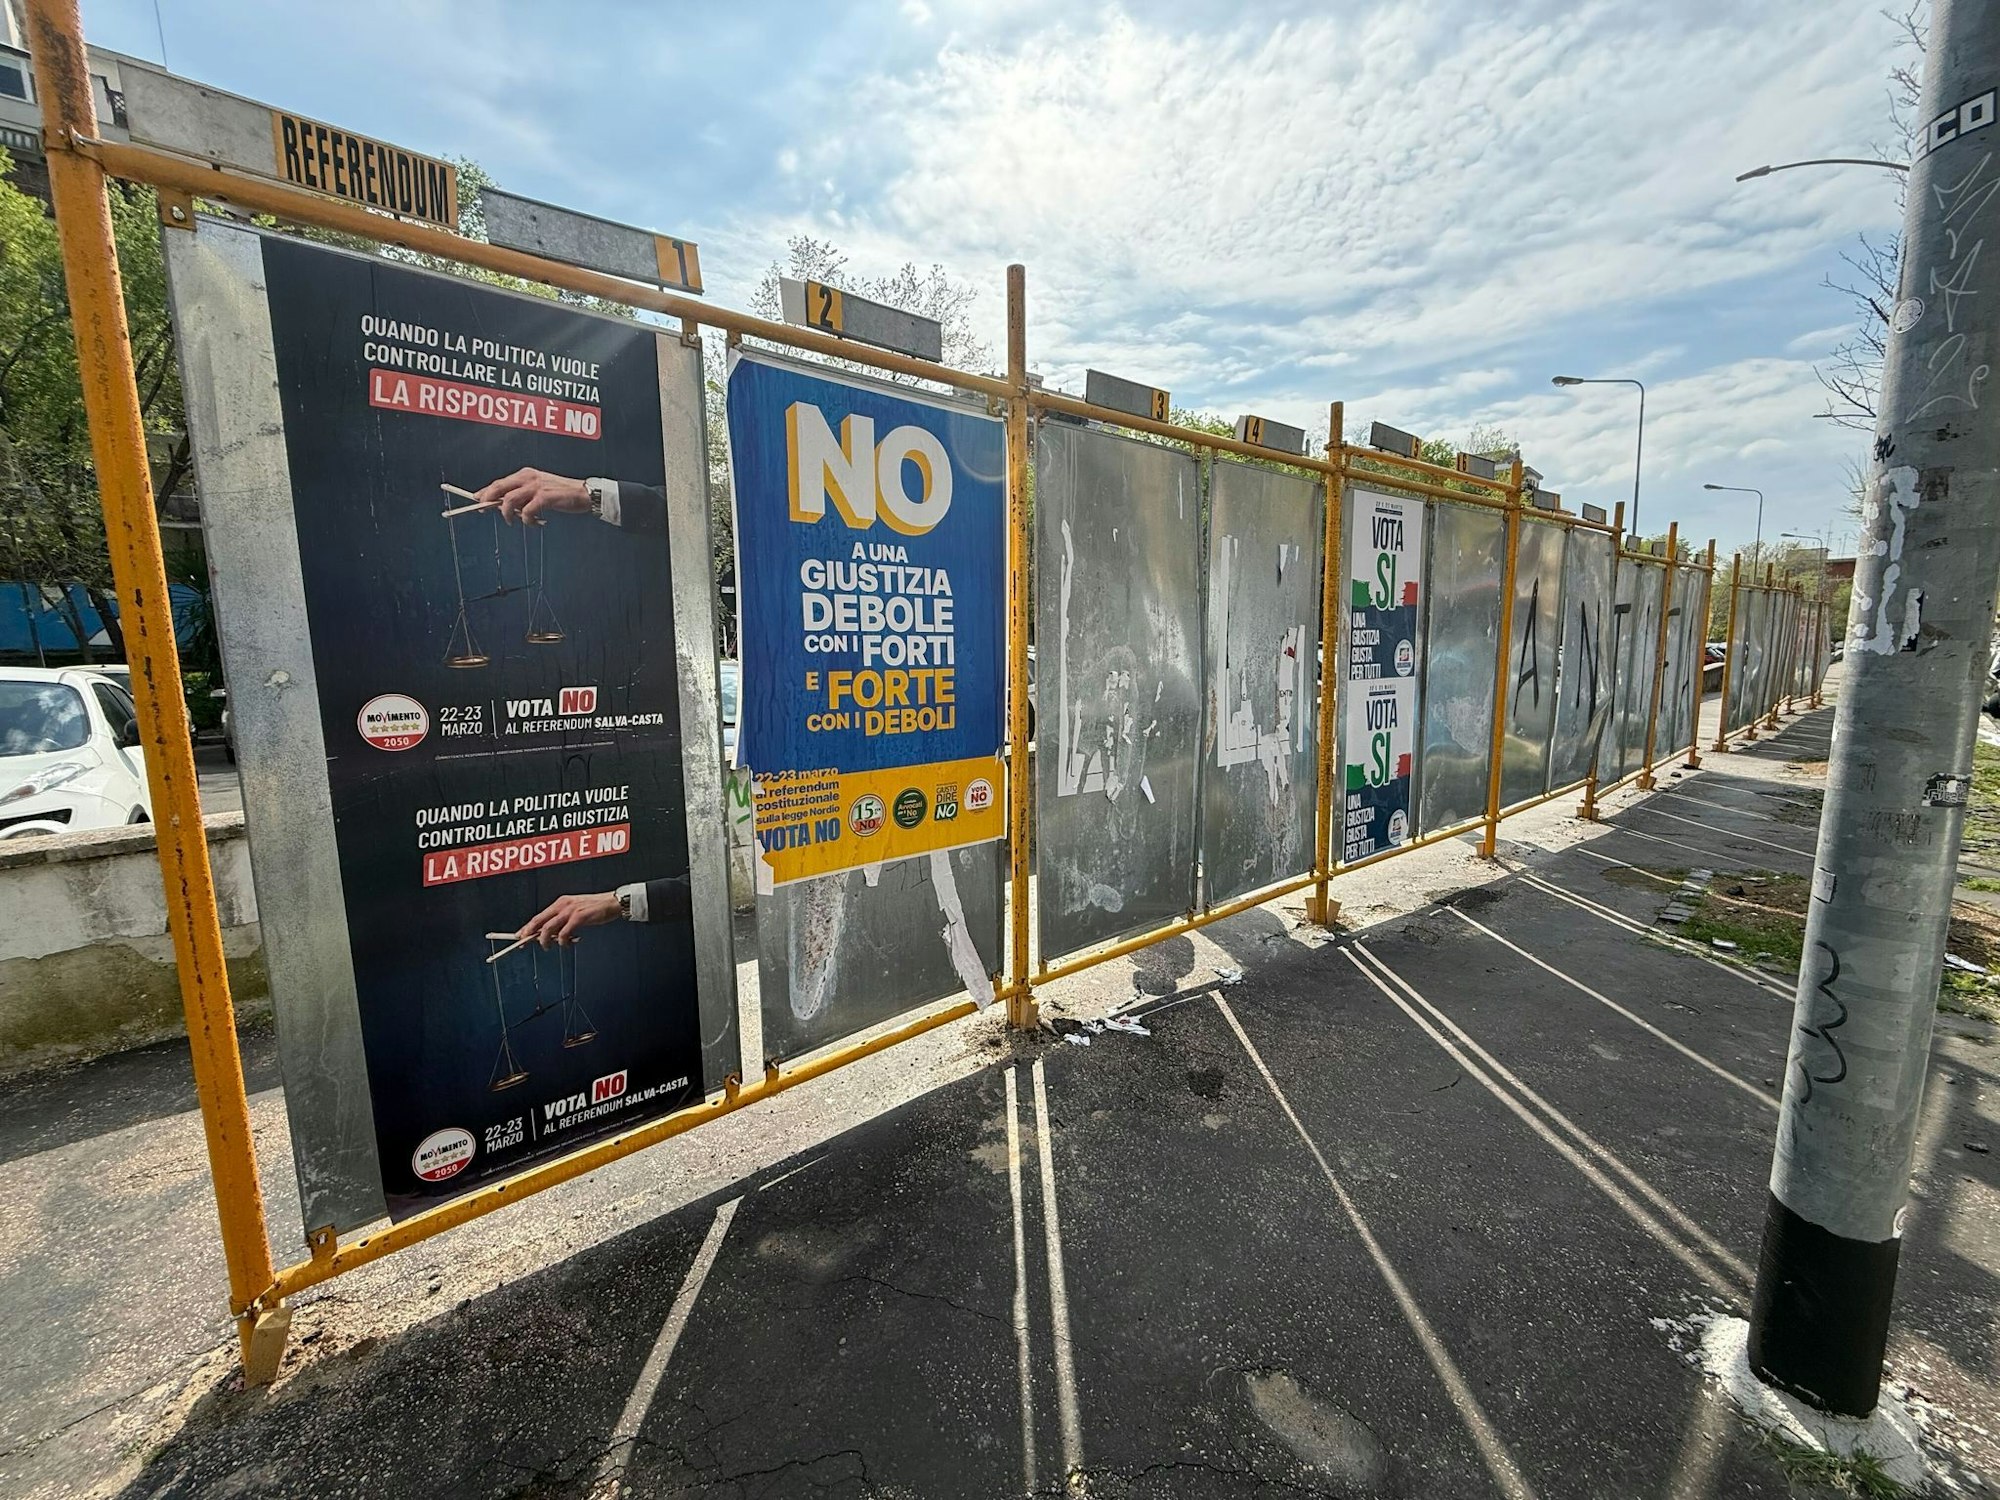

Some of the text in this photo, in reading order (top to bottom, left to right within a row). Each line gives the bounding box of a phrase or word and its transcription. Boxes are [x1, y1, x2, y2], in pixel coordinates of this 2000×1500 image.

[281, 115, 449, 224] REFERENDUM
[672, 240, 688, 286] 1
[819, 286, 833, 328] 2
[361, 314, 599, 380] QUANDO LA POLITICA VUOLE
[363, 342, 600, 403] CONTROLLARE LA GIUSTIZIA
[374, 375, 597, 436] LA RISPOSTA È NO
[1157, 392, 1164, 420] 3
[1252, 418, 1260, 443] 4
[785, 400, 953, 536] NO
[1372, 516, 1404, 552] VOTA
[852, 541, 909, 563] A UNA
[800, 558, 952, 596] GIUSTIZIA
[1375, 553, 1397, 609] SI
[802, 592, 954, 633] DEBOLE
[804, 633, 954, 667] CON I FORTI
[1352, 630, 1380, 646] GIUSTIZIA
[1351, 647, 1373, 663] GIUSTA
[1351, 665, 1364, 680] PER
[1364, 663, 1381, 679] TUTTI
[806, 668, 955, 710] E FORTE
[439, 705, 482, 722] 22-23
[506, 689, 594, 718] VOTA NO
[1366, 699, 1398, 731] VOTA
[367, 710, 421, 723] MOVIMENTO
[441, 721, 483, 736] MARZO
[505, 713, 663, 735] AL REFERENDUM SALVA-CASTA
[807, 706, 955, 737] CON I DEBOLI
[384, 736, 409, 747] 2050
[1370, 732, 1391, 787] SI
[799, 767, 839, 780] marzo
[756, 791, 840, 812] costituzionale
[769, 781, 839, 798] referendum
[936, 792, 957, 803] DIRE
[971, 792, 987, 803] NO
[415, 785, 629, 828] QUANDO LA POLITICA VUOLE
[756, 805, 840, 825] sulla legge Nordio
[855, 800, 874, 821] 15
[936, 803, 956, 819] NO
[1347, 806, 1375, 827] GIUSTIZIA
[418, 804, 629, 849] CONTROLLARE LA GIUSTIZIA
[756, 817, 841, 853] VOTA NO
[859, 819, 876, 830] NO
[1346, 824, 1367, 843] GIUSTA
[427, 829, 626, 882] LA RISPOSTA È NO
[1345, 838, 1375, 860] PER TUTTI
[543, 1075, 625, 1119] VOTA NO
[543, 1076, 688, 1136] AL REFERENDUM SALVA-CASTA
[485, 1116, 523, 1141] 22-23
[420, 1138, 468, 1162] MOVIMENTO
[486, 1131, 524, 1154] MARZO
[434, 1164, 458, 1179] 2050
